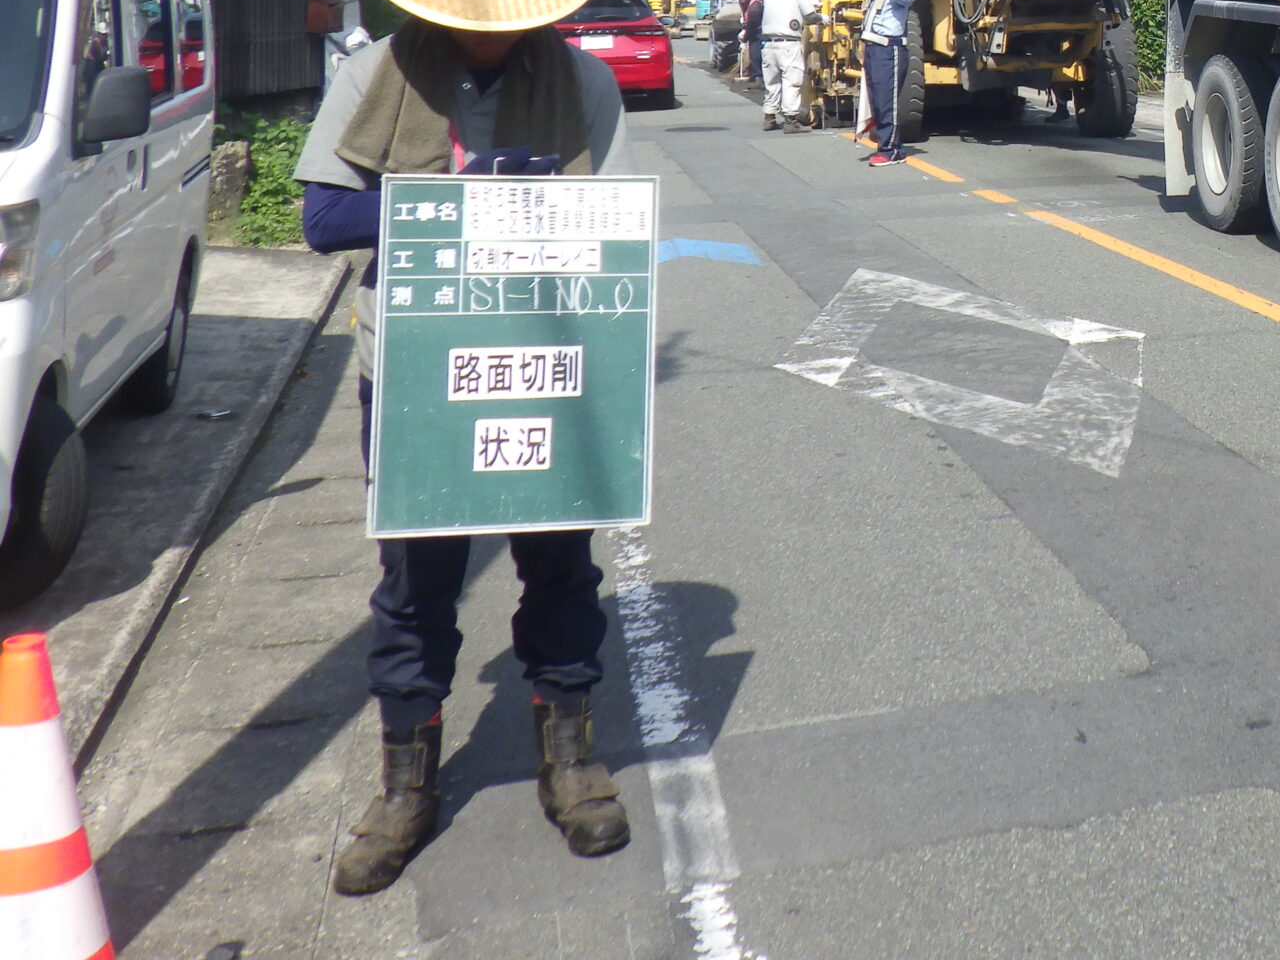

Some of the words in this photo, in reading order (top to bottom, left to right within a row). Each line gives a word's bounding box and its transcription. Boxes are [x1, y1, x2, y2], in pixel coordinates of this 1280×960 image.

[393, 201, 457, 222] 工事名
[453, 350, 579, 394] 路面切削
[478, 426, 547, 469] 状況
